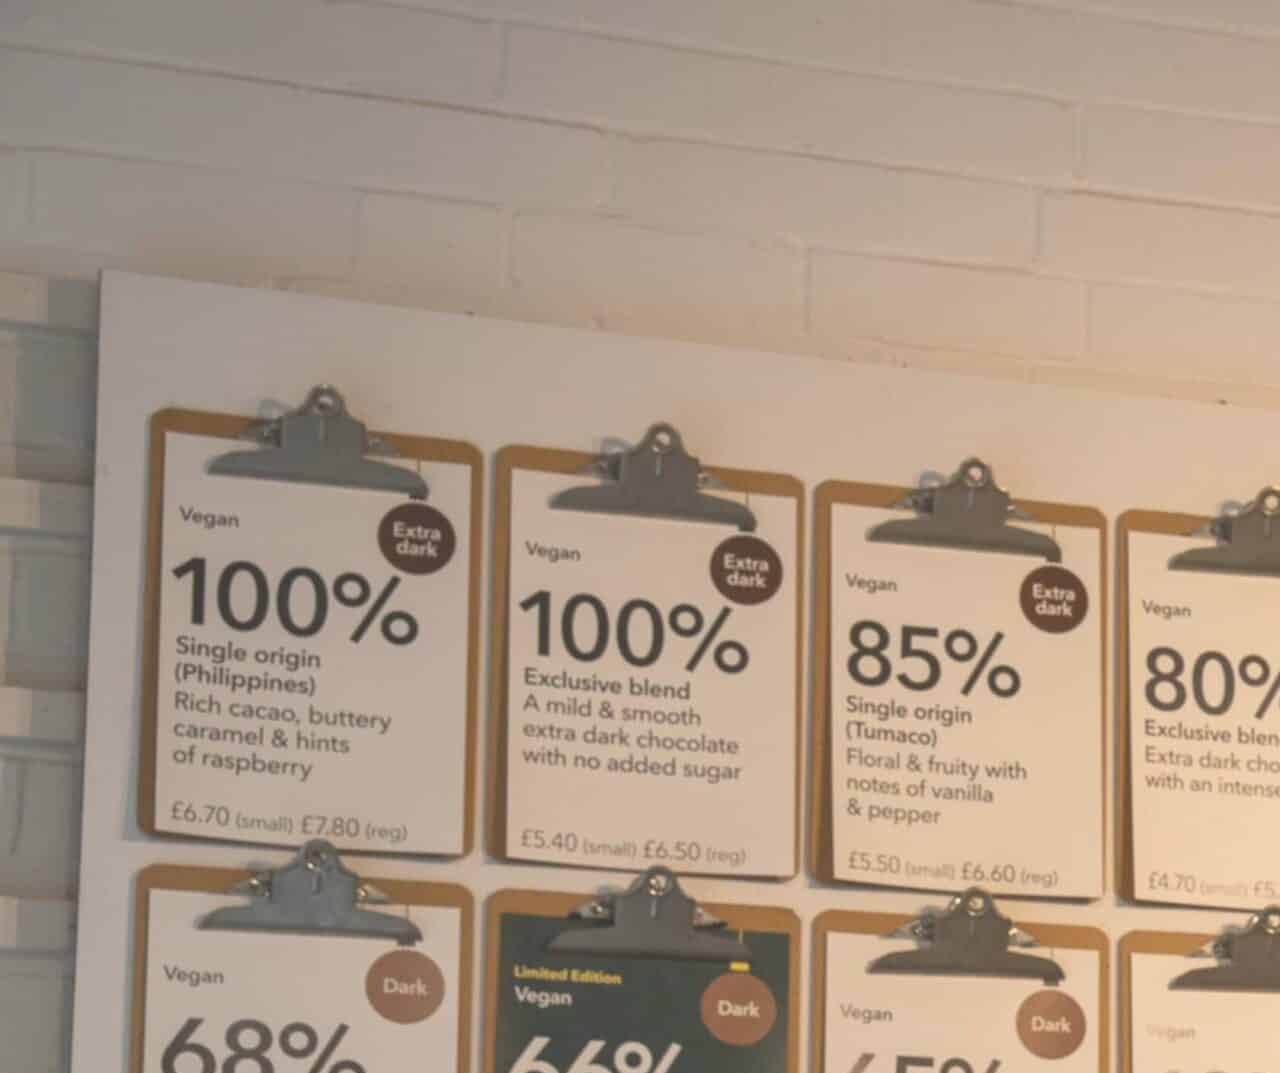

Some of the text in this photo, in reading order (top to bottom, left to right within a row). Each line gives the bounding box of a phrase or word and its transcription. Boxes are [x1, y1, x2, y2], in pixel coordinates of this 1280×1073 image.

[179, 505, 239, 530] Vegan
[392, 521, 441, 541] Extra
[395, 538, 438, 558] dark
[172, 557, 420, 646] 100%
[1032, 583, 1076, 601] Extra
[1035, 599, 1072, 616] dark
[1142, 599, 1191, 620] Vegan
[520, 590, 749, 674] 100%
[176, 635, 320, 672] Single origin
[847, 619, 1020, 698] 85%
[173, 662, 318, 698] (Philippines)
[524, 666, 690, 704] Exclusive blend
[173, 723, 349, 753] caramel & hints
[523, 723, 741, 755] extra dark chocolate
[846, 719, 937, 748] (Tumaco)
[1144, 718, 1231, 743] Exclusive
[173, 745, 312, 782] of raspberry
[846, 746, 1027, 785] Floral & fruity with
[384, 976, 428, 996] Dark
[514, 962, 621, 985] Limited Edition
[1032, 1016, 1072, 1034] Dark
